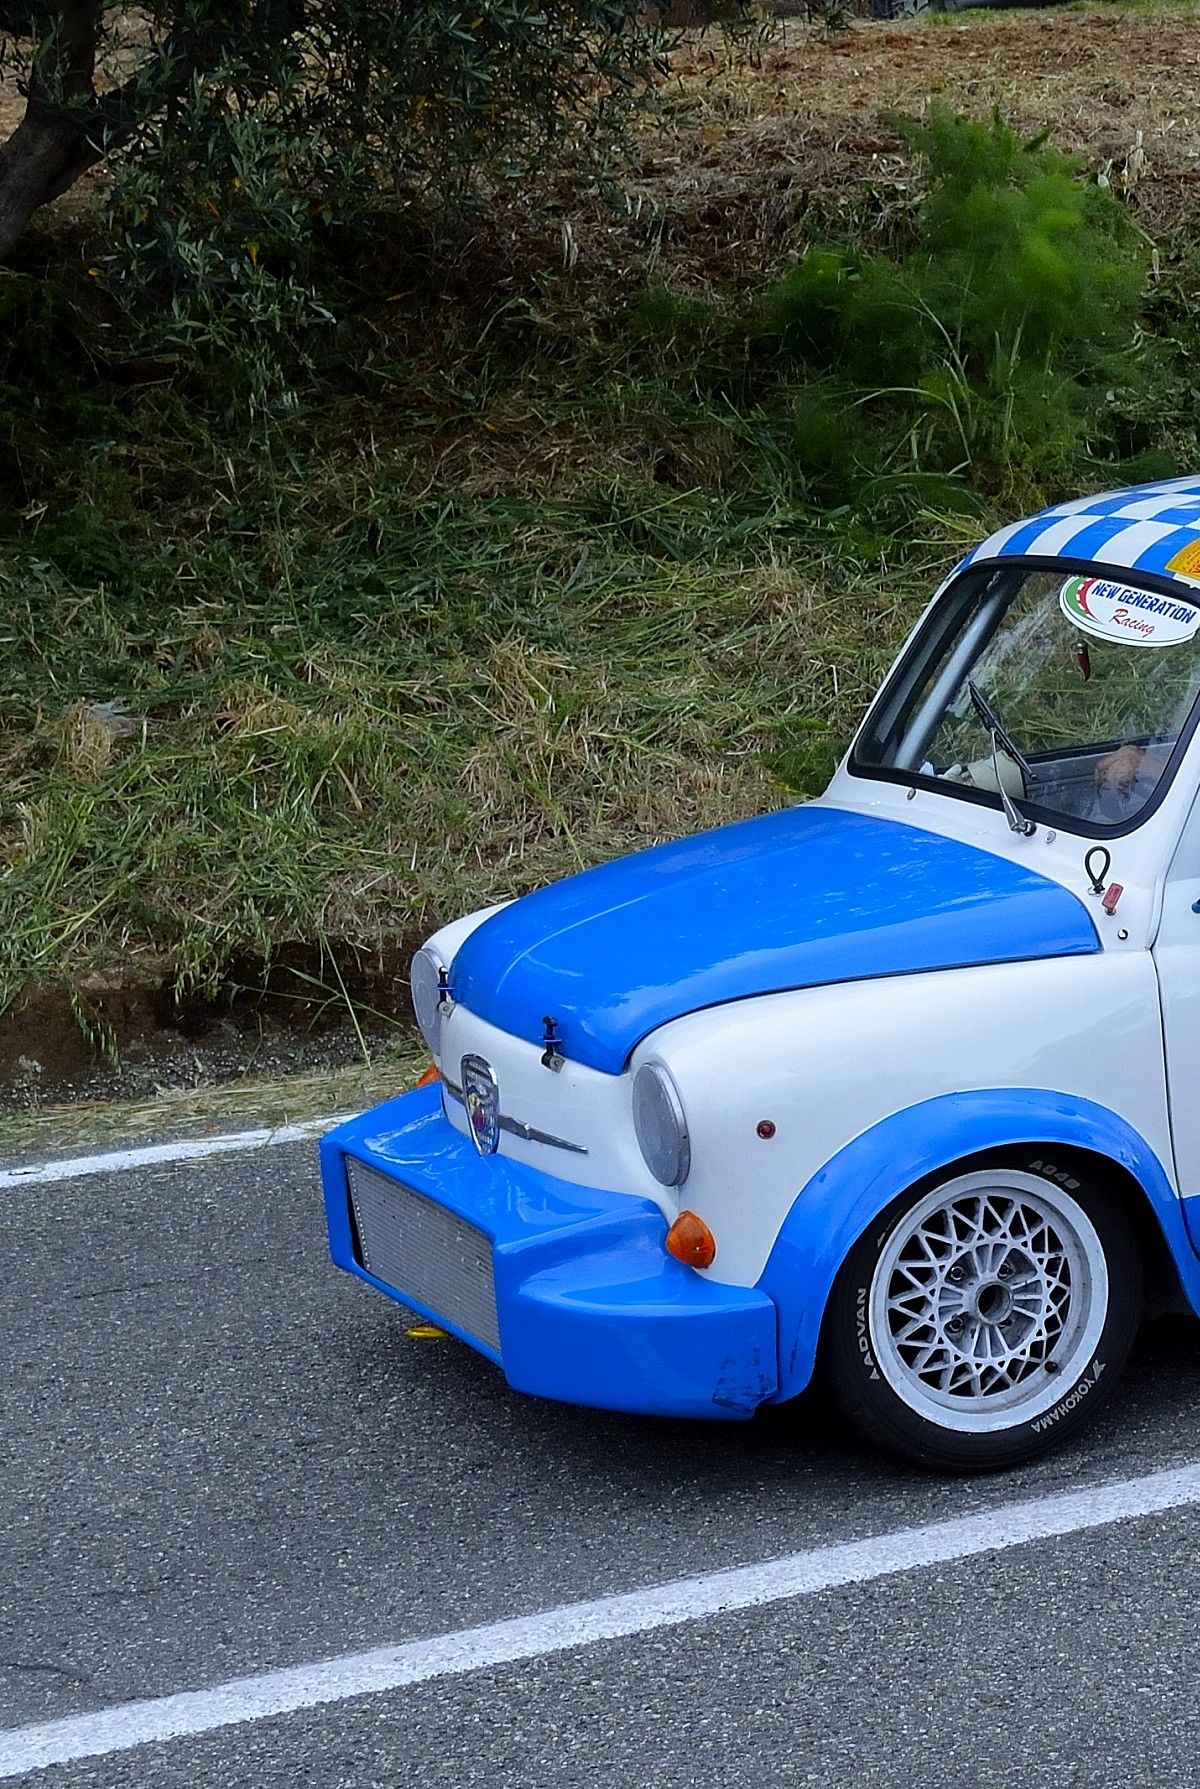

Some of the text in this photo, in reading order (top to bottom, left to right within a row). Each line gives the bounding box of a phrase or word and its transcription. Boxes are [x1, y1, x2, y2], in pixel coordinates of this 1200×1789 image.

[1092, 581, 1198, 624] NEW GENERATION
[1109, 608, 1156, 638] Racing
[856, 1287, 876, 1367] ADVAN
[1031, 1376, 1094, 1434] YOKOHAMA
